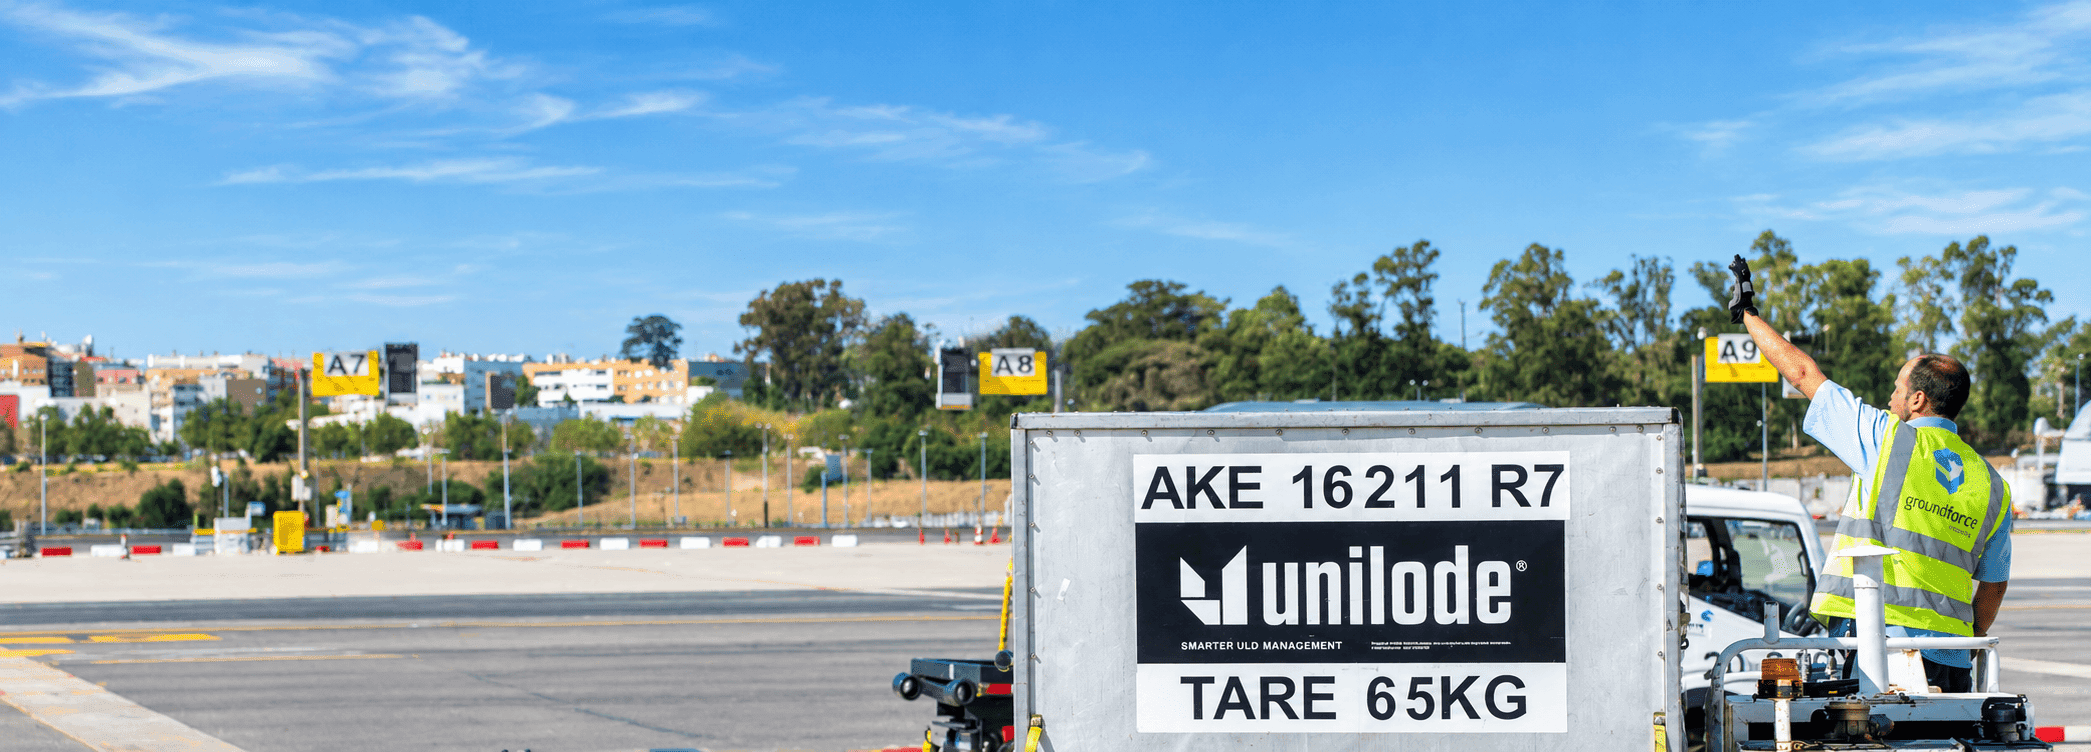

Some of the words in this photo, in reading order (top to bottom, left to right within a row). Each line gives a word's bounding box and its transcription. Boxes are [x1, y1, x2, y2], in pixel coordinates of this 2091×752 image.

[1721, 339, 1757, 361] A9
[327, 354, 365, 374] A7
[995, 355, 1032, 374] A8
[1141, 466, 1263, 509] AKE
[1293, 465, 1460, 508] 16211
[1492, 464, 1564, 507] R7
[1904, 496, 1978, 529] groundforce
[1181, 641, 1233, 650] SMARTER
[1237, 641, 1258, 650] ULD
[1263, 641, 1342, 650] MANAGEMENT
[1181, 676, 1336, 719] TARE
[1367, 675, 1526, 720] 65KG
